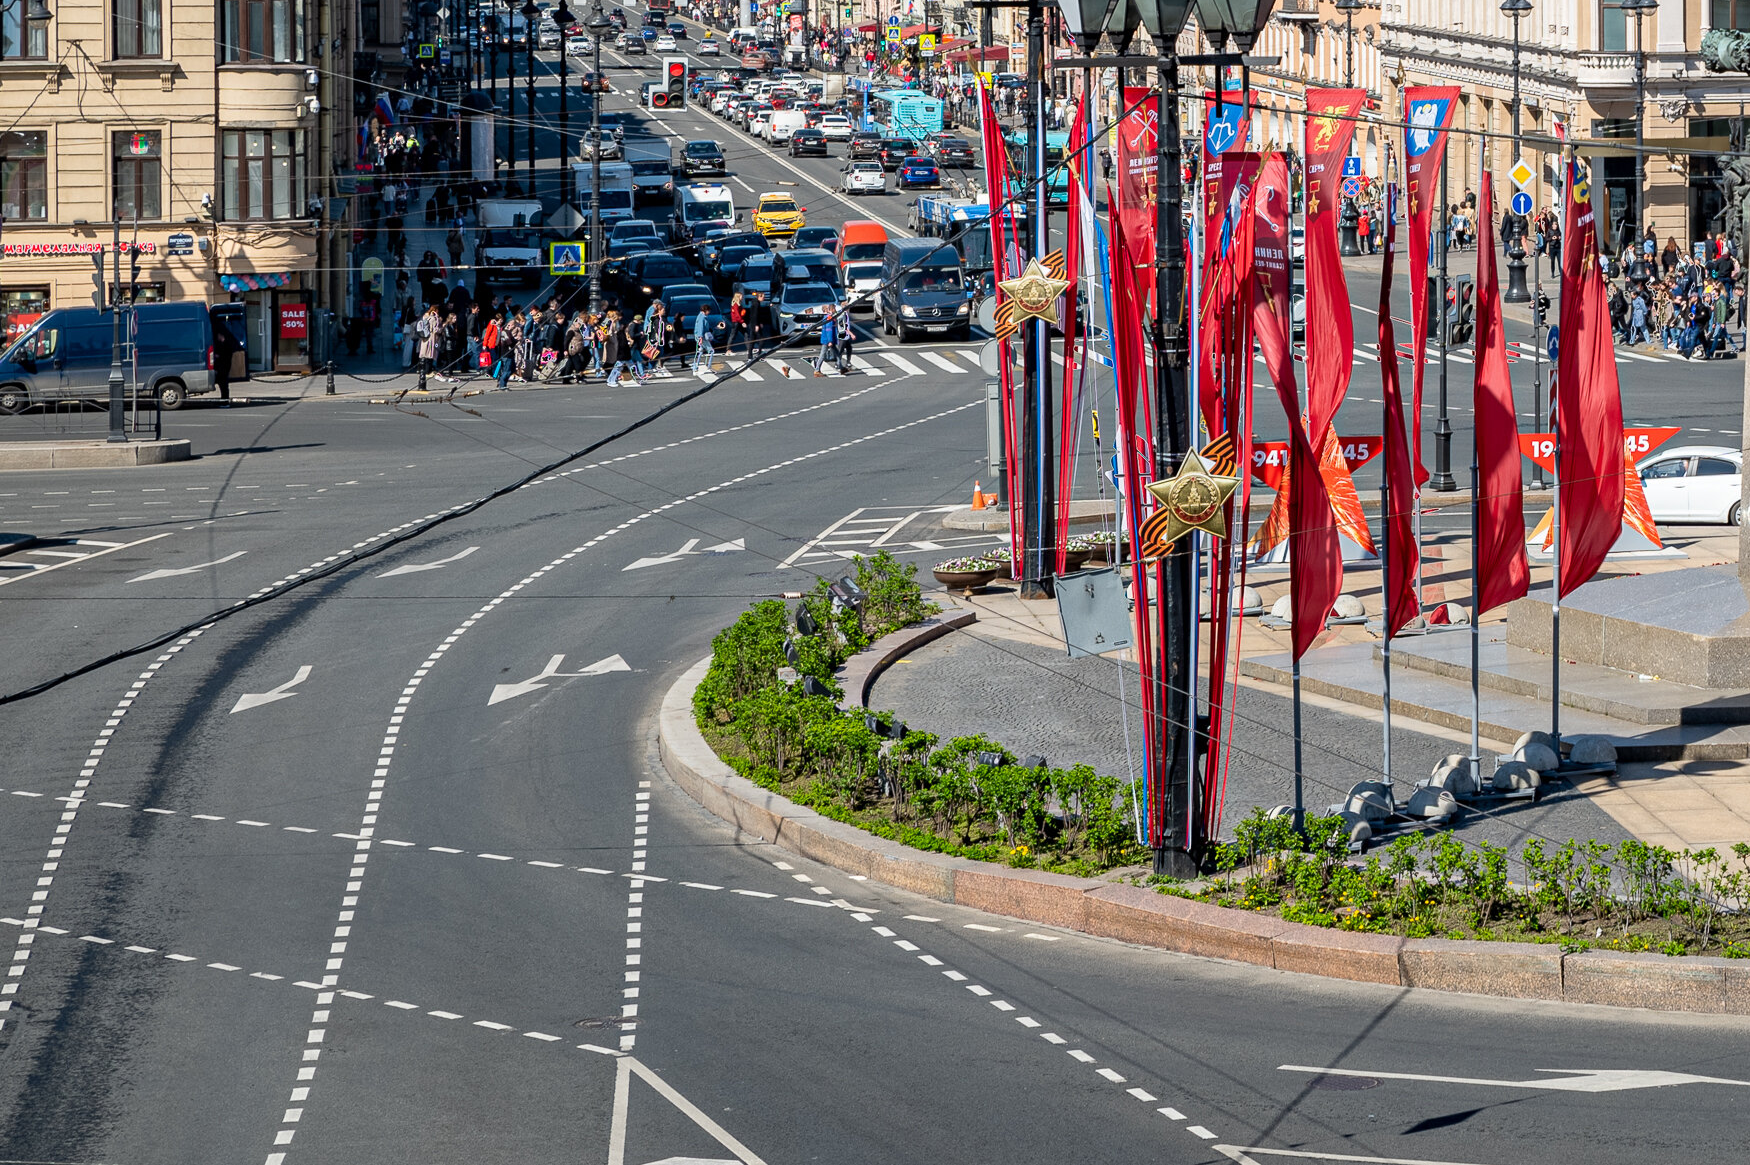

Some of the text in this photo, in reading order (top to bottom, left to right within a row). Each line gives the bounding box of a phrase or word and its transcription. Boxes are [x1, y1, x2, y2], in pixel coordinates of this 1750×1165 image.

[4, 242, 101, 253] мармеладная
[282, 310, 305, 318] SALE
[9, 323, 31, 334] SA
[1531, 435, 1650, 458] 19 45
[1252, 443, 1370, 467] 941 45
